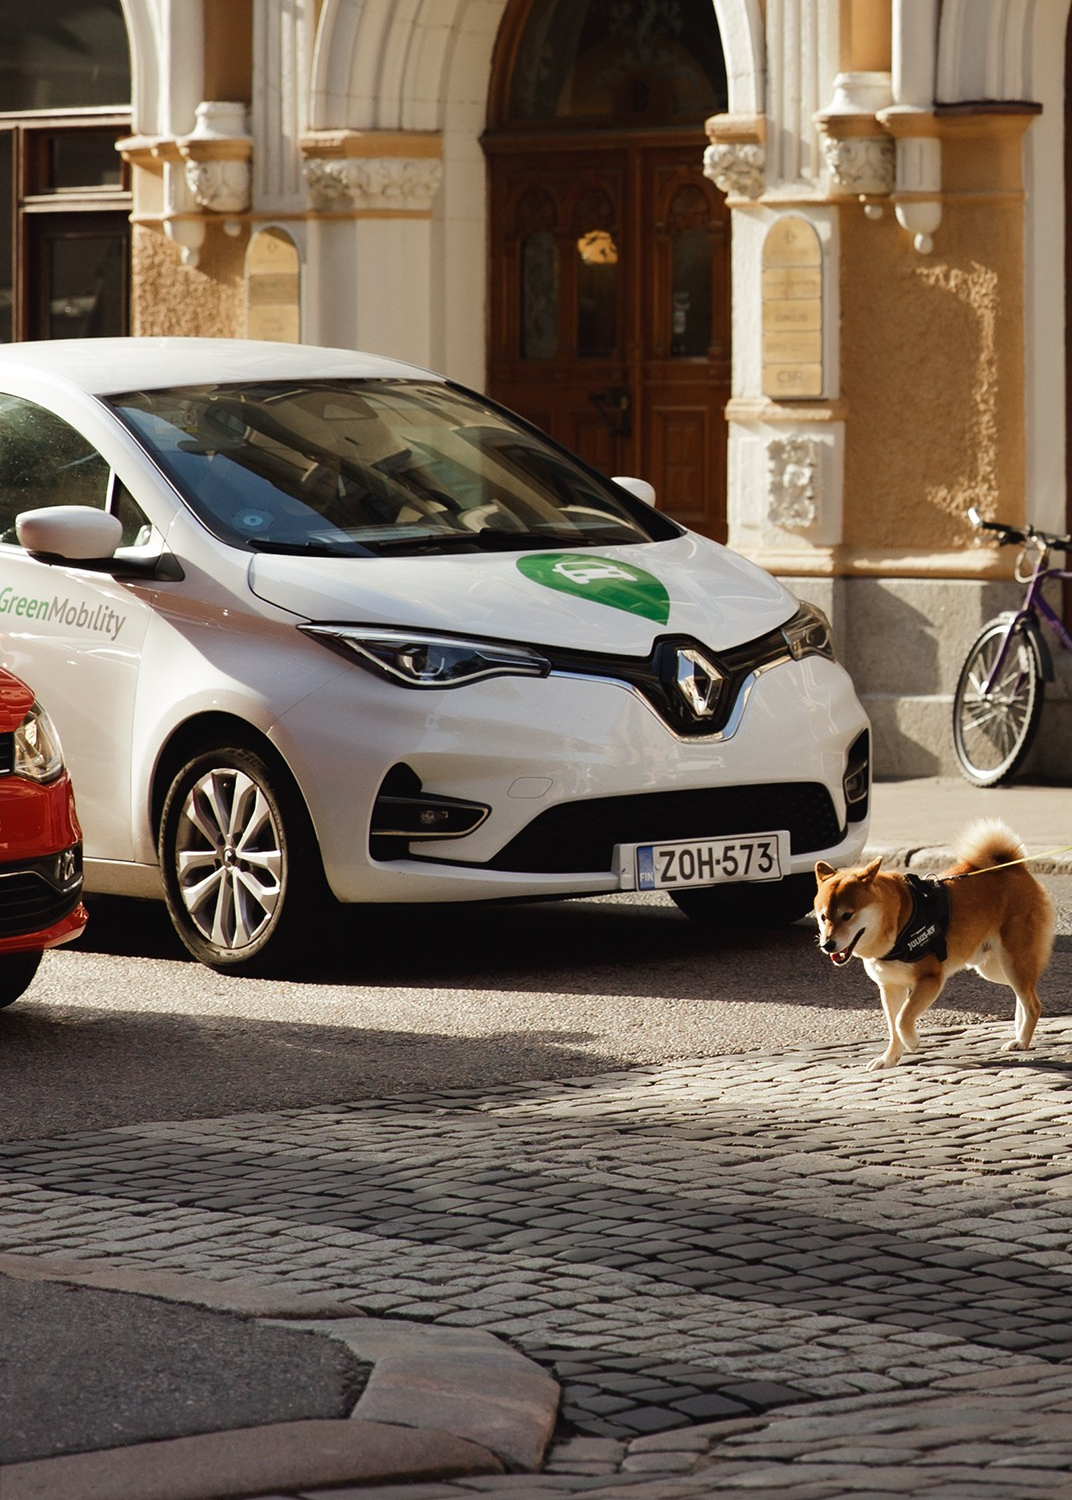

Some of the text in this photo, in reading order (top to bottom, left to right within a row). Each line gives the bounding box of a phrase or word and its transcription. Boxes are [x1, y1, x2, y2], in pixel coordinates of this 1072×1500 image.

[0, 587, 126, 641] GreenMobility
[639, 872, 654, 882] FIN
[659, 842, 773, 883] ZOH-573
